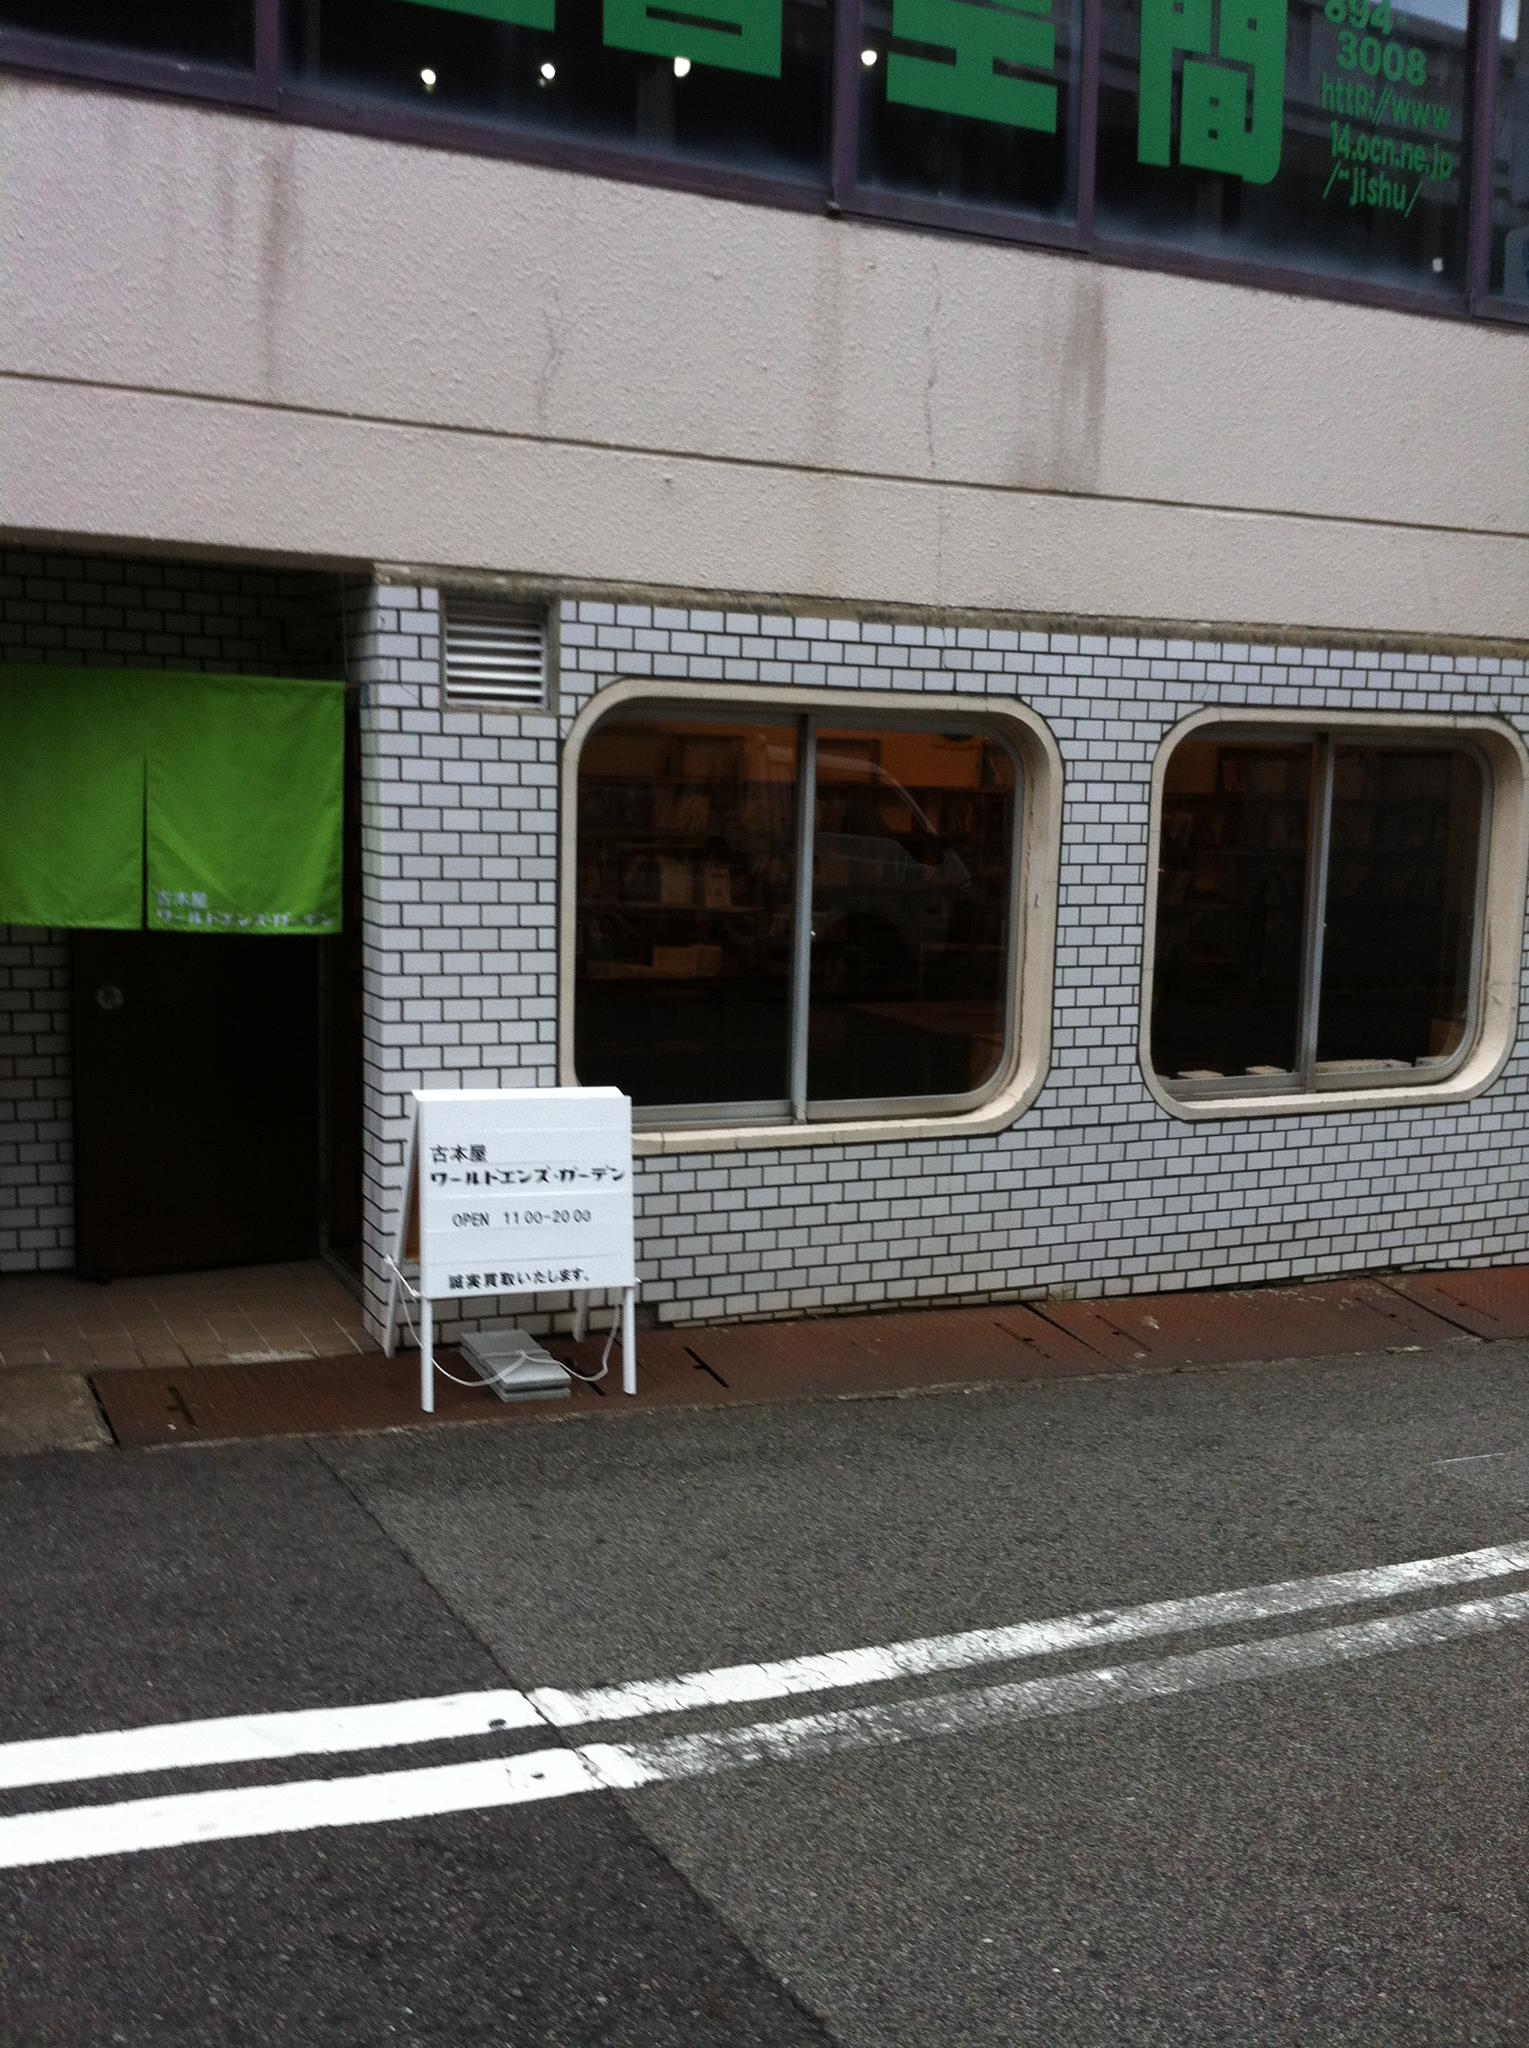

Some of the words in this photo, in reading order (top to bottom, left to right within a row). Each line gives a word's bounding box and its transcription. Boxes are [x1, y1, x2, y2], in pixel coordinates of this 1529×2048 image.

[1336, 31, 1426, 87] 3008
[1330, 120, 1454, 182] 14.ocn.ne.jp
[429, 1144, 489, 1164] 古本屋
[451, 1211, 491, 1228] OPEN
